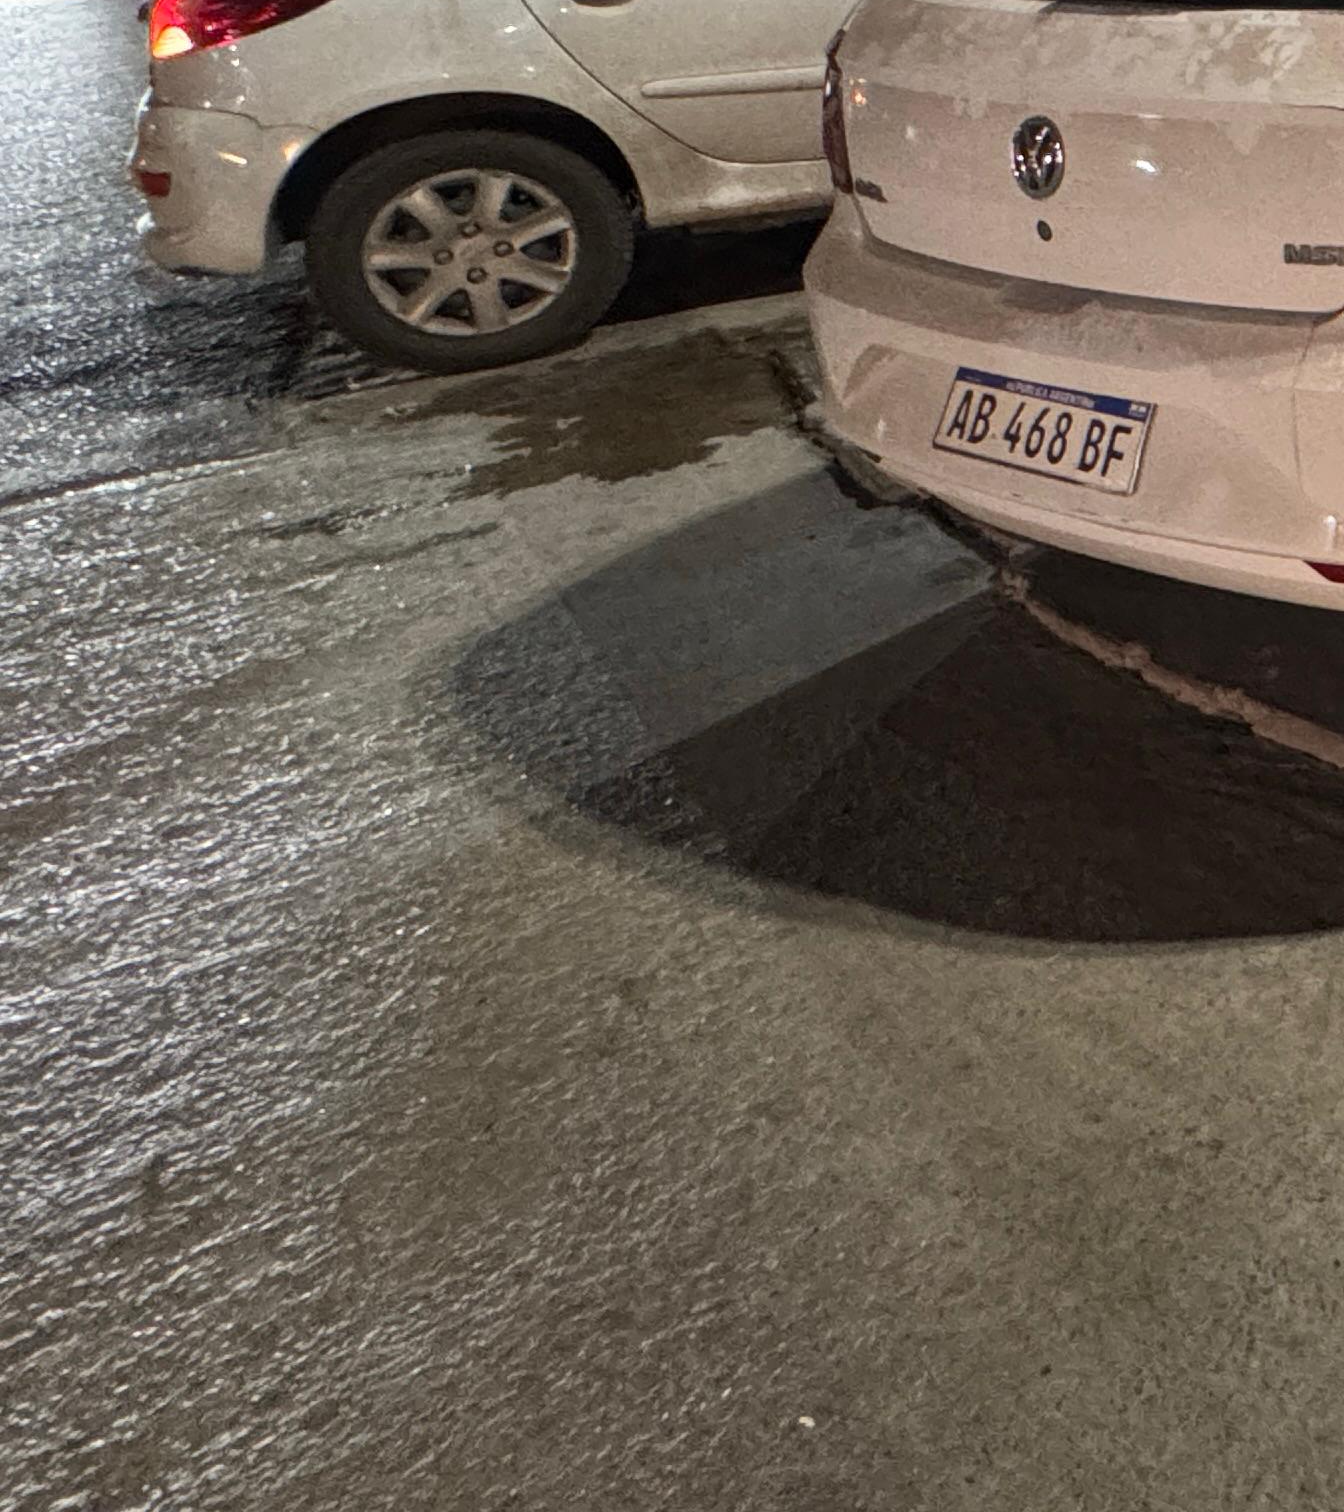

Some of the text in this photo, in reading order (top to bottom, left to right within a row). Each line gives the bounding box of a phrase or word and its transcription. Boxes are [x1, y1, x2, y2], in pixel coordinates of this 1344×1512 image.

[946, 389, 1134, 478] AB 468 BF
